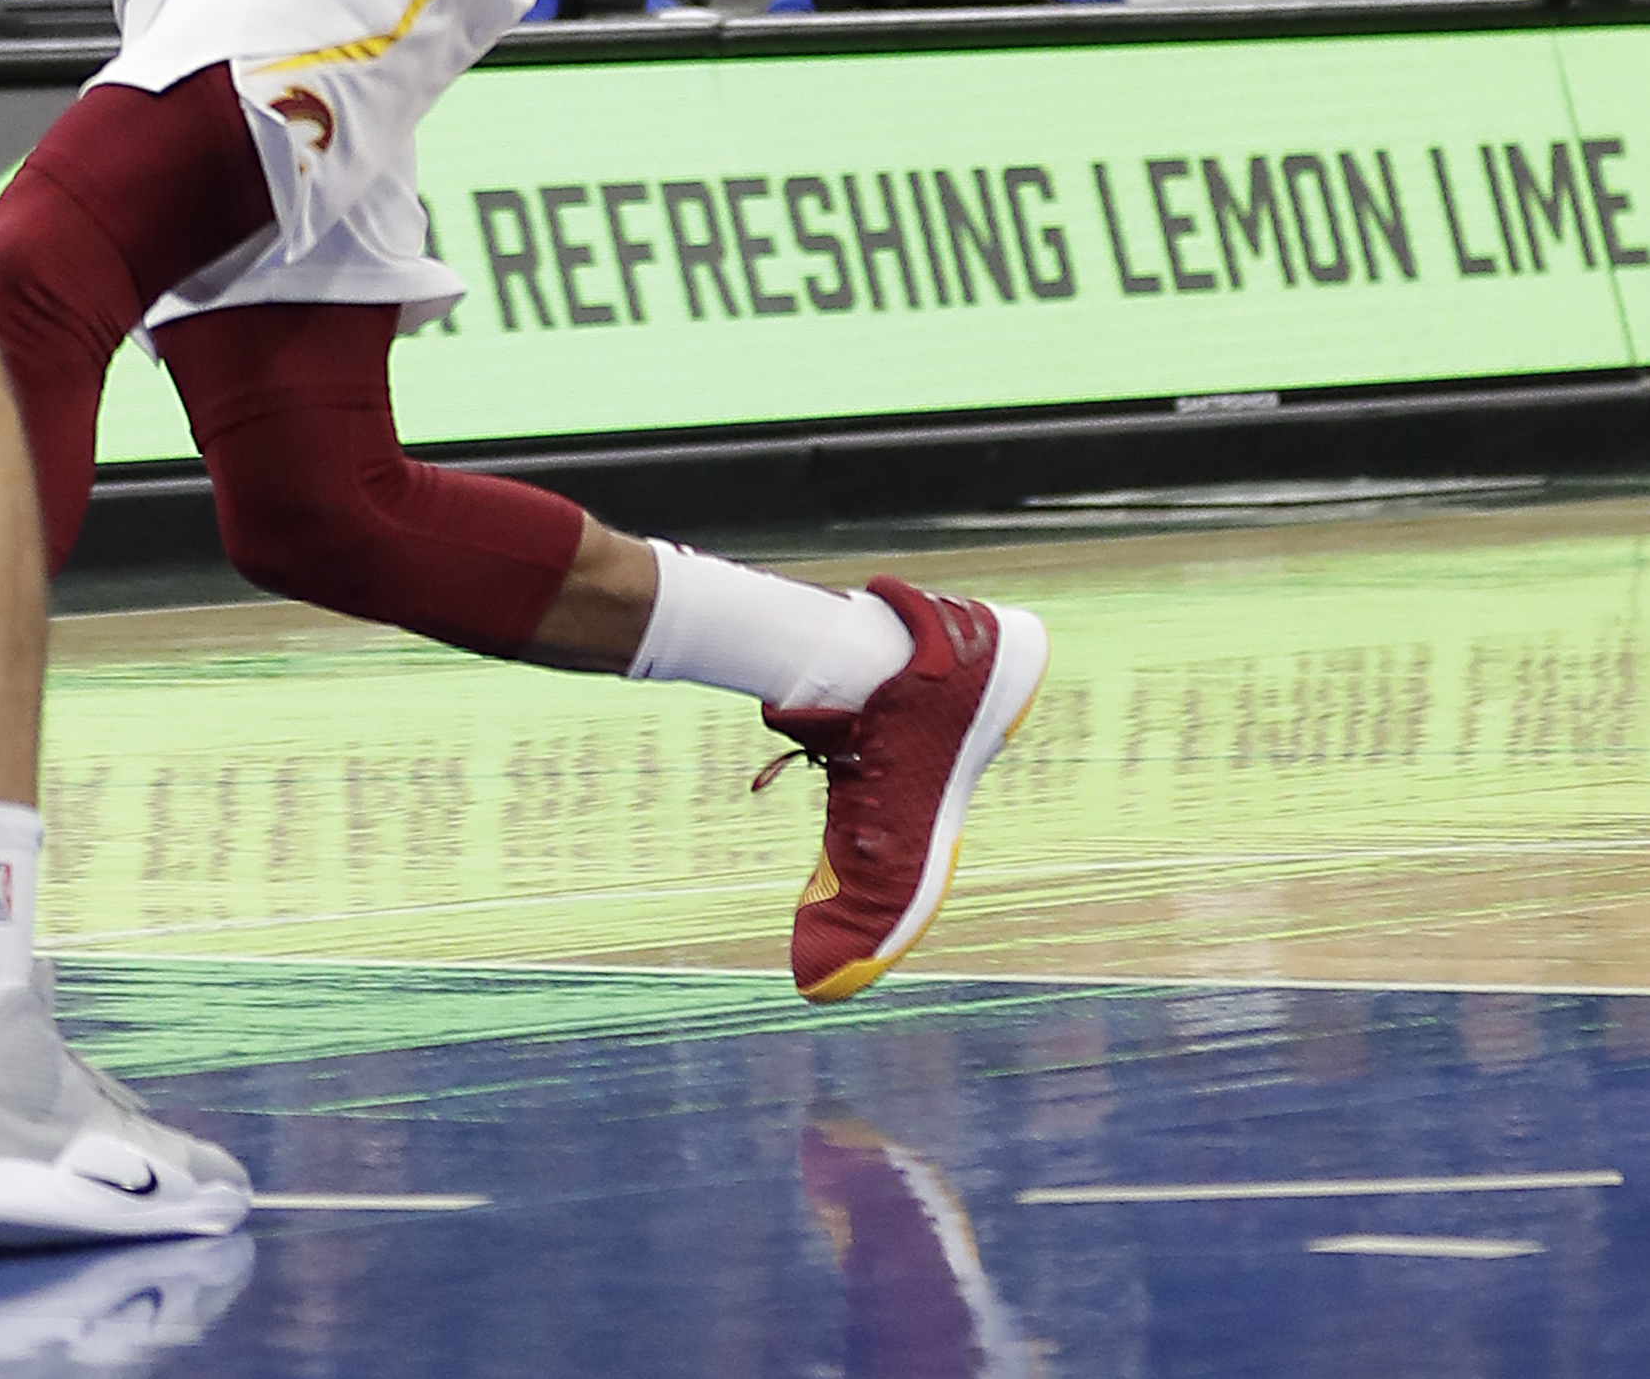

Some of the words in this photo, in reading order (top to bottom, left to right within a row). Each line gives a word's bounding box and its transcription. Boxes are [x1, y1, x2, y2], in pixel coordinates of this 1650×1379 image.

[472, 165, 1077, 330] REFRESHING
[1092, 150, 1417, 295] LEMON
[1430, 138, 1650, 276] LIME
